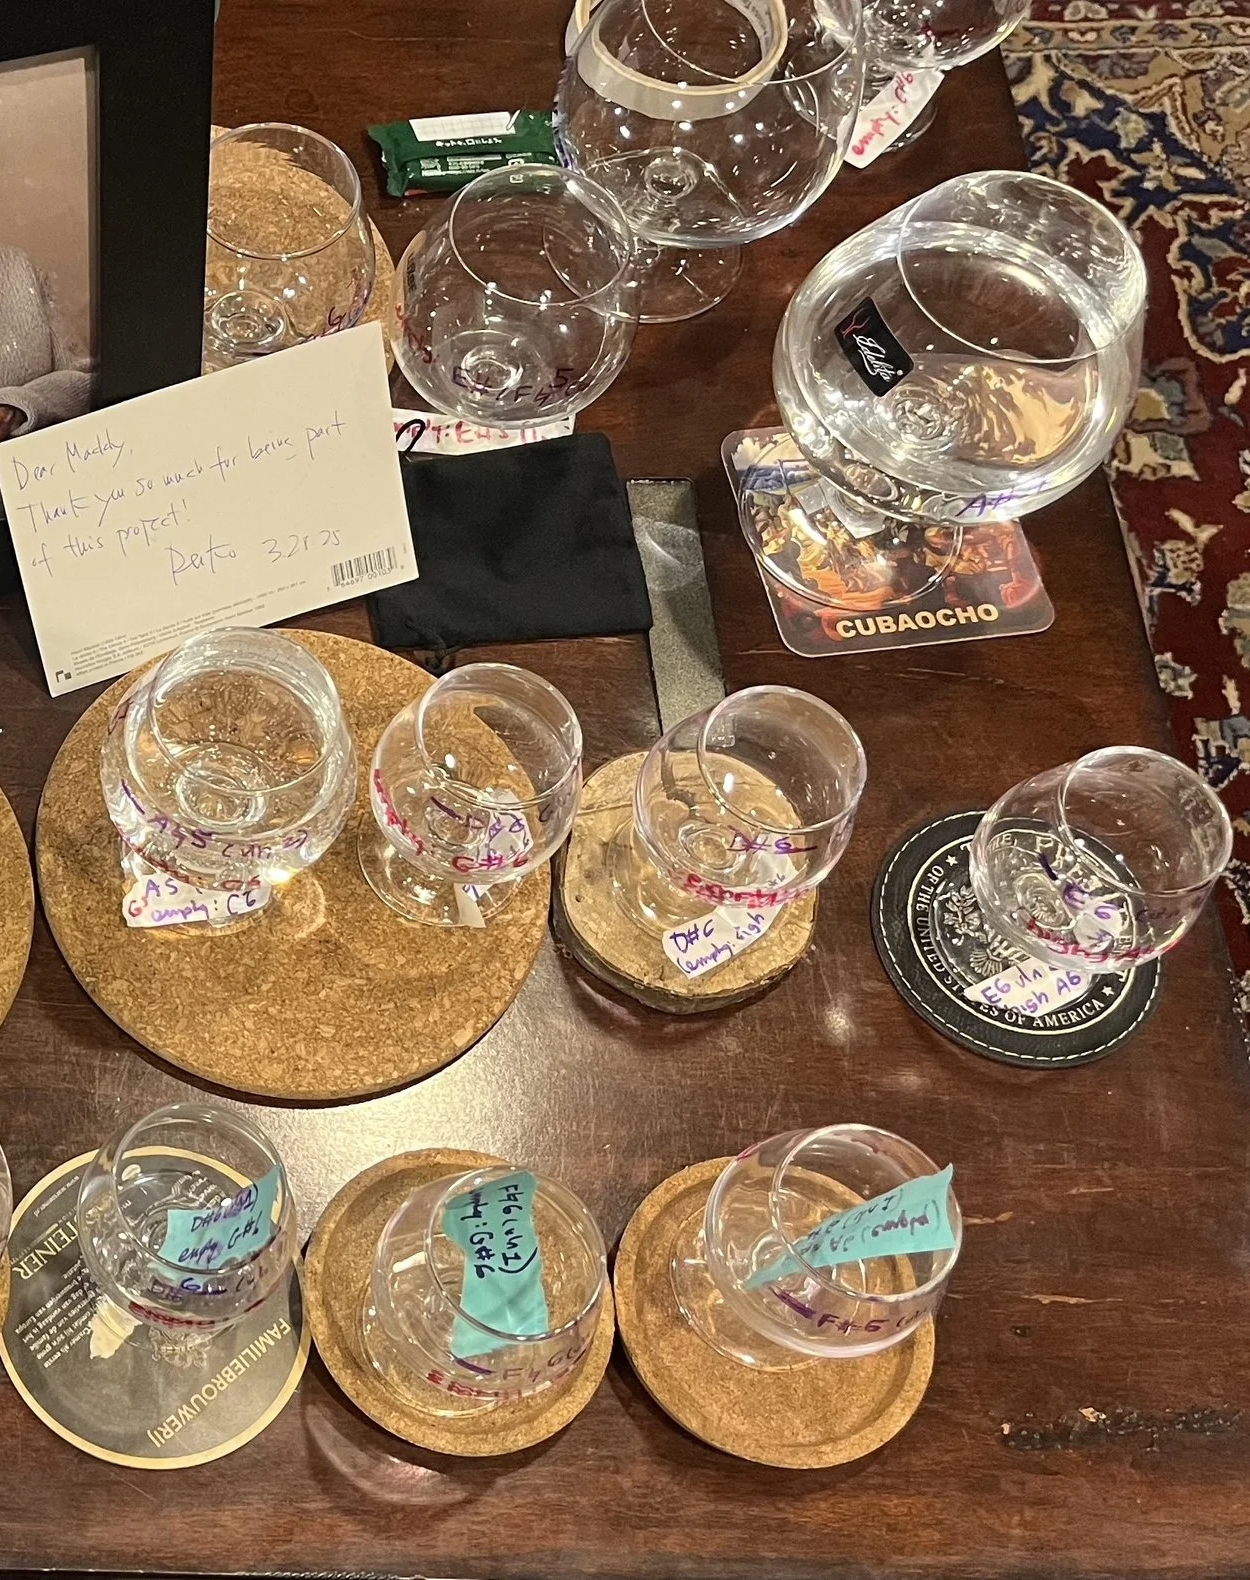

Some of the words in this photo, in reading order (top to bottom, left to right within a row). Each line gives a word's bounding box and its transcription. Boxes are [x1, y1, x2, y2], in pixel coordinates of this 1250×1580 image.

[12, 455, 56, 491] Dear
[65, 428, 134, 469] Maddy,
[17, 491, 89, 534] Thank
[94, 486, 125, 527] you
[135, 478, 154, 498] so
[163, 459, 205, 488] much
[209, 445, 239, 482] for
[250, 432, 297, 462] being
[304, 410, 348, 459] part
[31, 547, 54, 577] of
[64, 532, 104, 560] this
[835, 603, 1000, 639] CUBAOCHO
[929, 865, 945, 884] OF
[916, 884, 934, 913] THE
[917, 915, 949, 975] UNITED
[1031, 998, 1106, 1029] AMERICA
[146, 1317, 291, 1448] FAMILIEBROUWERIJ
